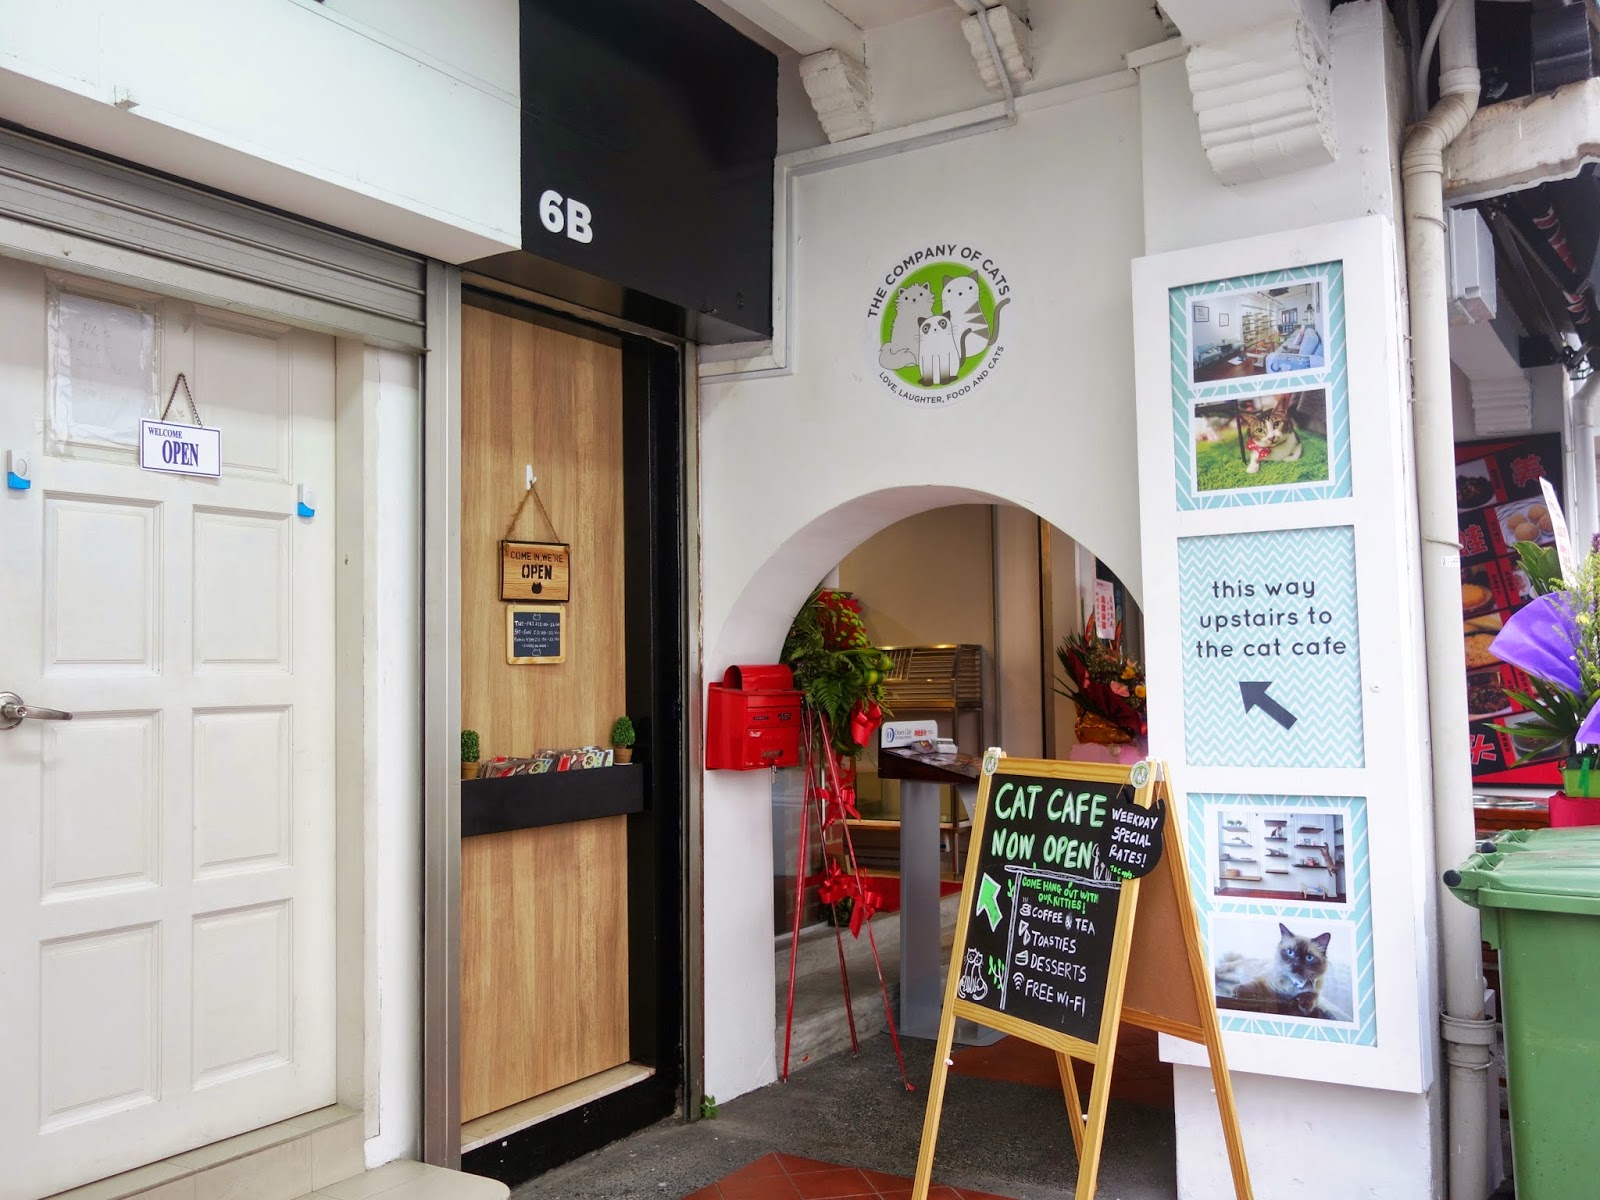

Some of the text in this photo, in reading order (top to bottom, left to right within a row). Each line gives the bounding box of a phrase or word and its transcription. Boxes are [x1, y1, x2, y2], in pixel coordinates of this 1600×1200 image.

[539, 189, 593, 244] 6B
[867, 244, 1010, 318] THE COMPANY OF CATS
[879, 346, 1004, 404] LOVE, LAUGHTER, FOOD AND CATS
[148, 427, 182, 439] WELCOME
[162, 440, 199, 467] OPEN
[510, 551, 532, 561] COME
[522, 564, 552, 580] OPEN
[1212, 580, 1315, 599] this way
[1200, 607, 1332, 632] upstairs to
[1196, 637, 1346, 658] the cat cafe
[995, 782, 1107, 827] CAT CAFE
[1112, 808, 1158, 829] WEEKDAY
[991, 828, 1093, 870] NOW OPEN
[1111, 826, 1151, 848] SPECIAL
[1109, 844, 1147, 868] RATES!
[1022, 876, 1099, 904] COME HANG OUT WITH
[1038, 893, 1086, 915] OUR KITTIES!
[1031, 906, 1063, 923] COFFEE
[1075, 918, 1095, 936] TEA
[1031, 929, 1077, 954] TOASTIES
[1030, 953, 1087, 982] DESSERTS
[1025, 979, 1054, 1003] FREE
